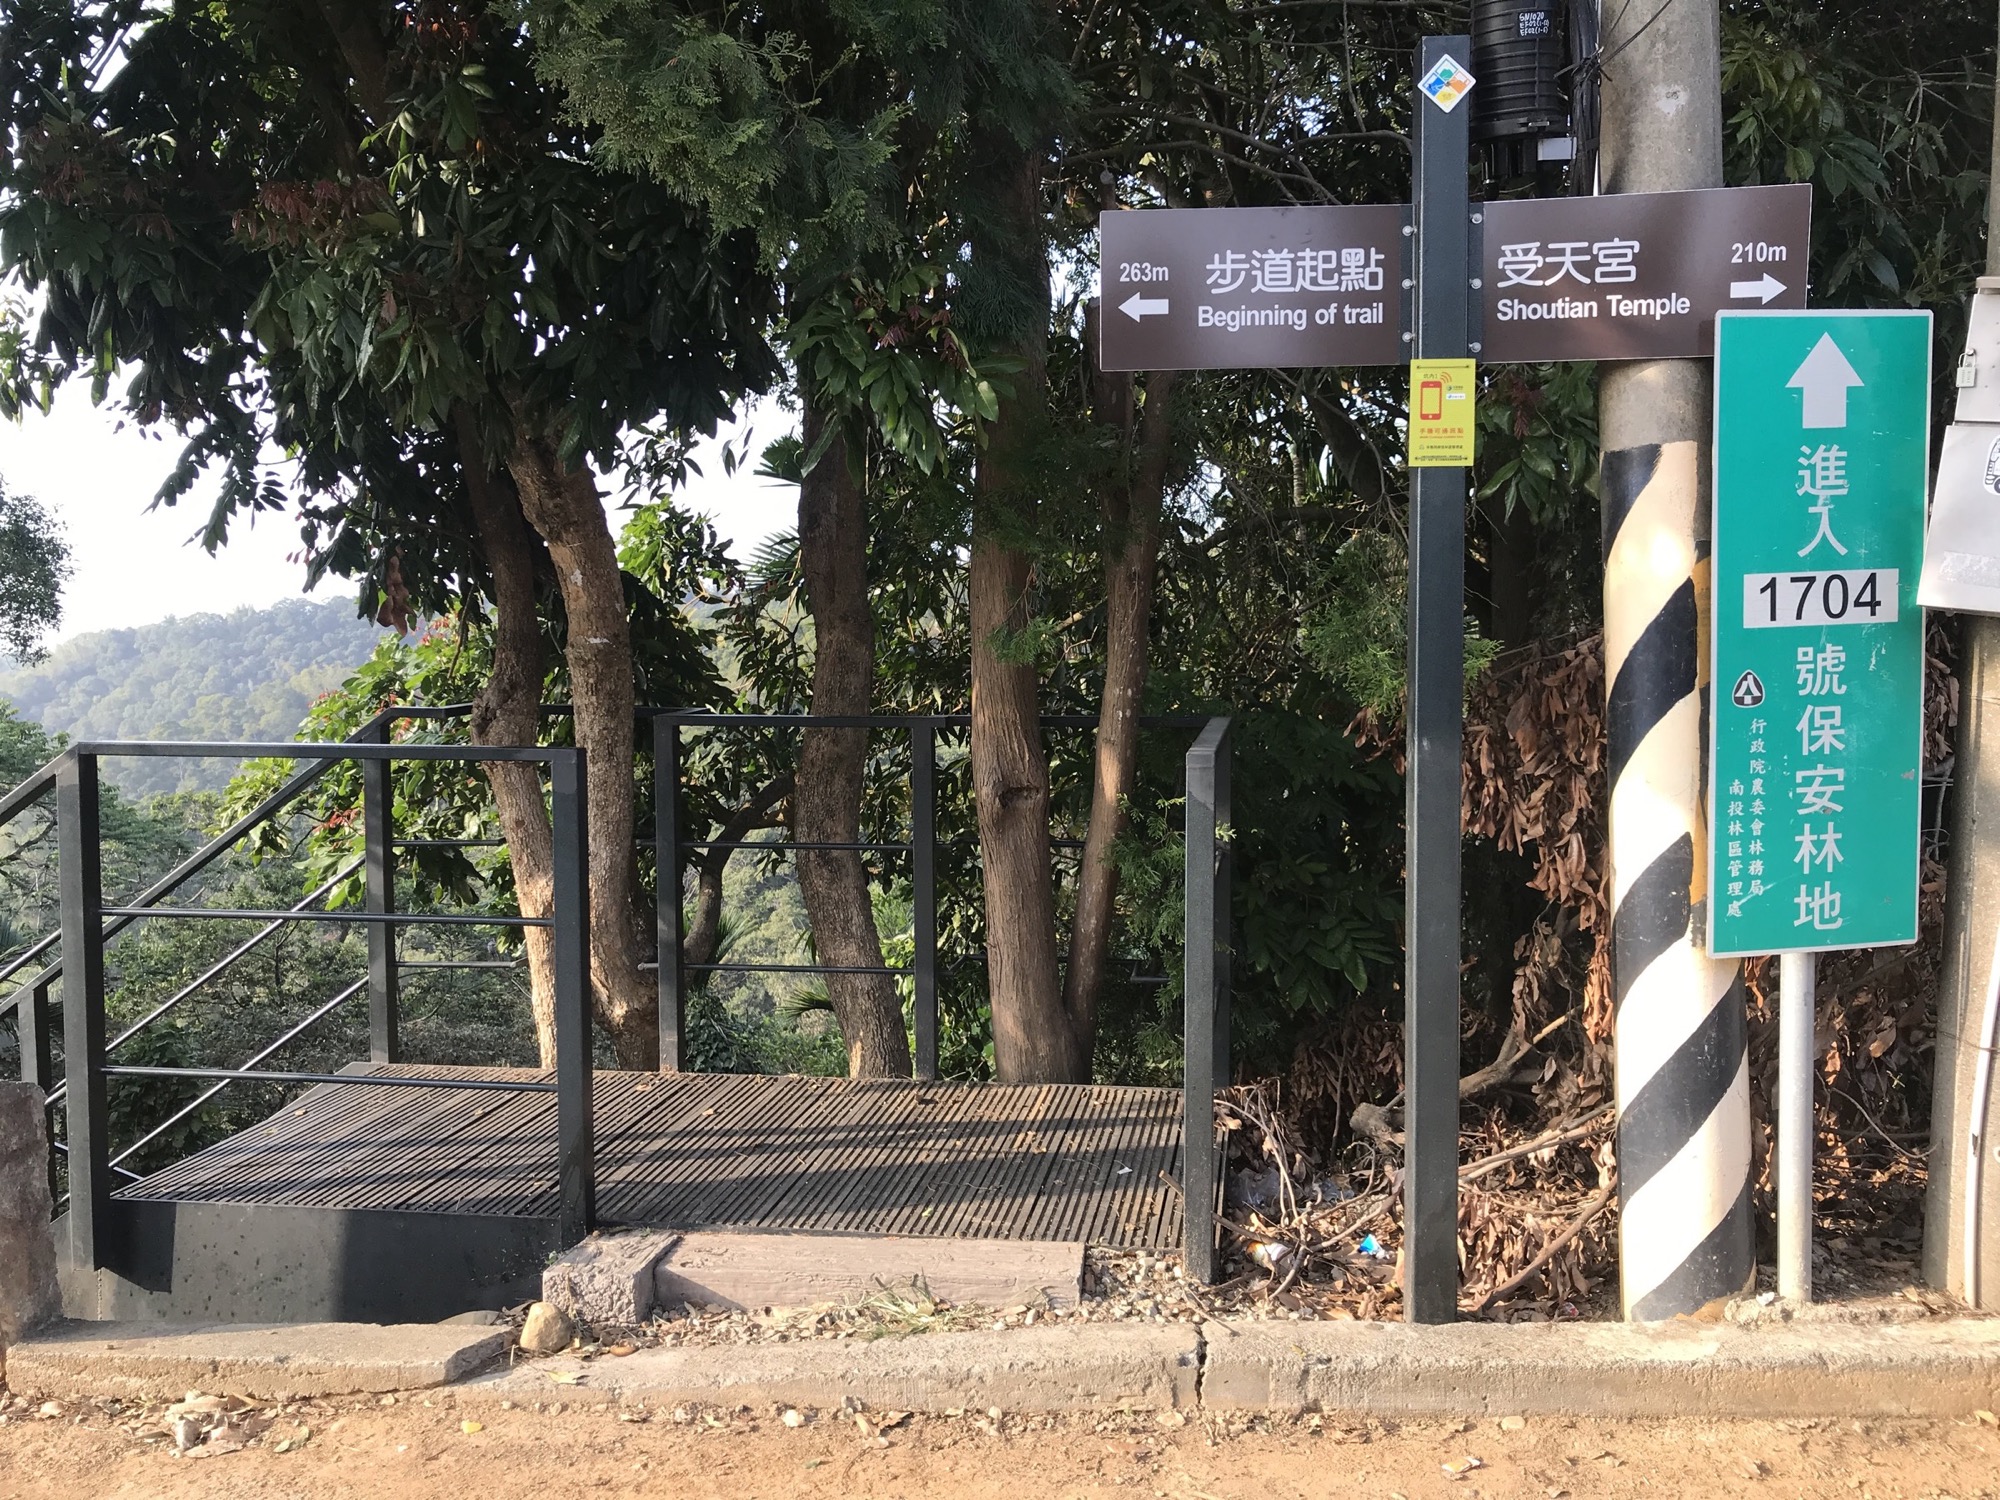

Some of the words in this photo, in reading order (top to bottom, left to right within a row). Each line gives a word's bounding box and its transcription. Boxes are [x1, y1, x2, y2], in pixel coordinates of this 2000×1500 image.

[1119, 262, 1169, 282] 263m
[1205, 247, 1385, 294] 步道起點
[1497, 237, 1640, 288] 受天宮
[1731, 243, 1787, 264] 210m
[1197, 303, 1307, 332] Beginning
[1314, 303, 1338, 326] of
[1342, 302, 1384, 325] trail
[1496, 296, 1598, 321] Shoutian
[1606, 292, 1691, 320] Temple
[1796, 444, 1849, 558] 進入
[1759, 571, 1882, 622] 1704
[1748, 718, 1767, 896] 行政院農委會林務局
[1793, 643, 1848, 931] 號保安林地
[1726, 779, 1745, 917] 南投林區管理處
